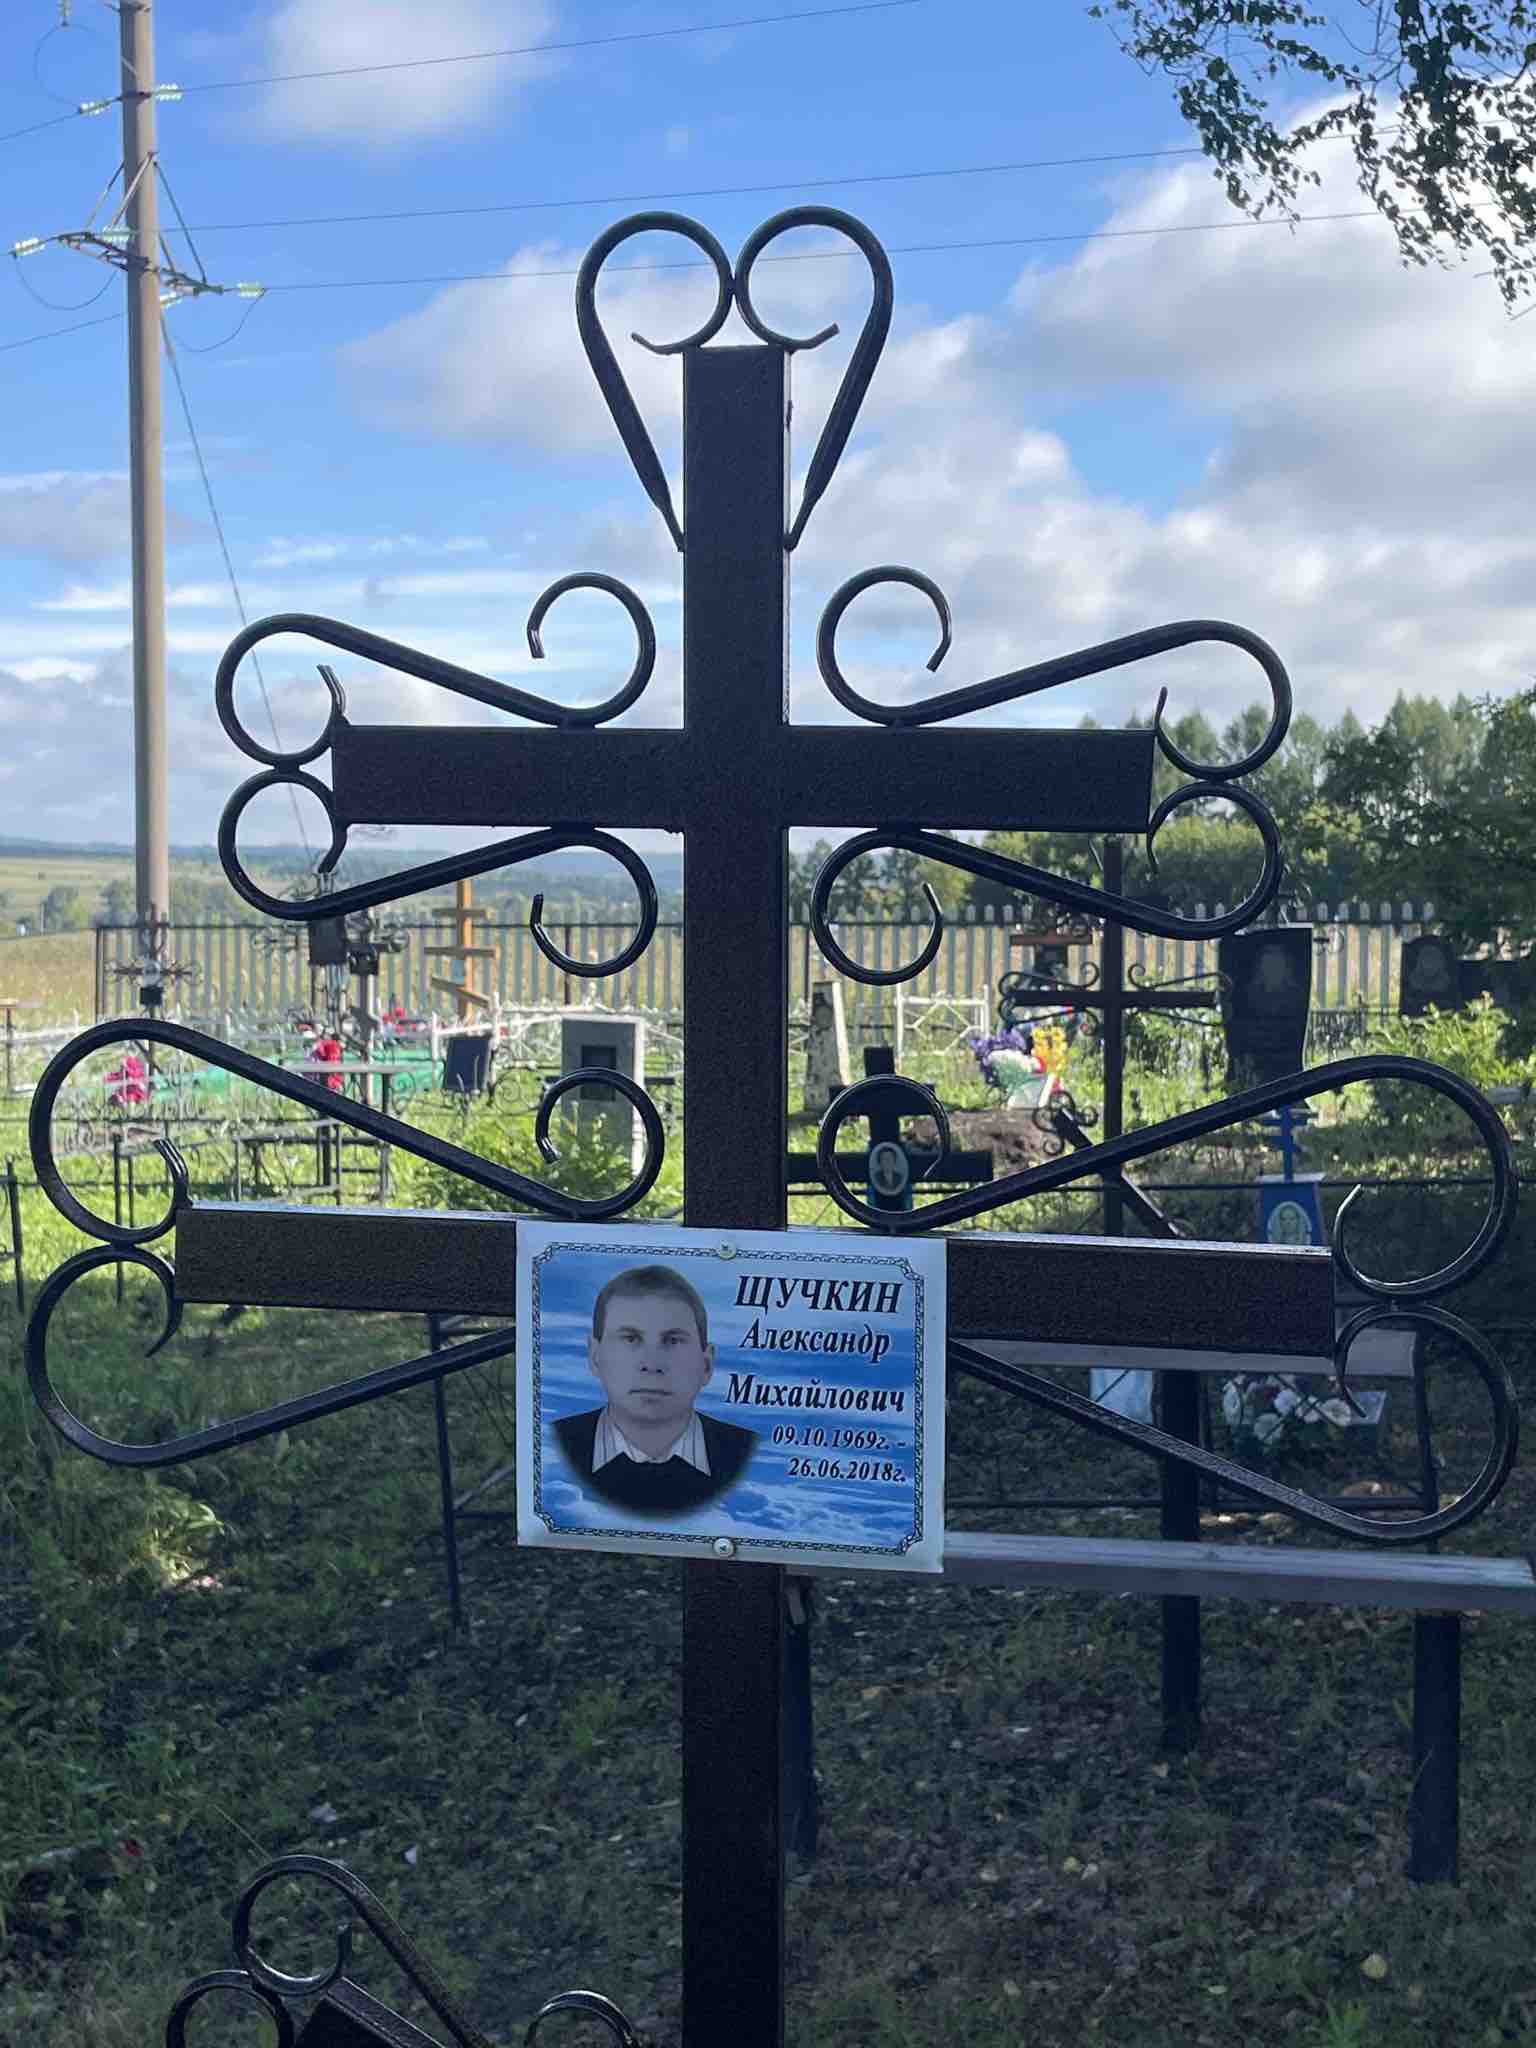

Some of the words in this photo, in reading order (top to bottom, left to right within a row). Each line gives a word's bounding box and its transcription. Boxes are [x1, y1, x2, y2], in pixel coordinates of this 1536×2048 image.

[734, 1275, 902, 1315] ЩУЧКИН
[739, 1318, 890, 1363] Александр
[725, 1373, 905, 1412] Михайлович
[773, 1425, 889, 1450] 09.10.1969г.
[788, 1457, 906, 1483] 26.06.2018г.
